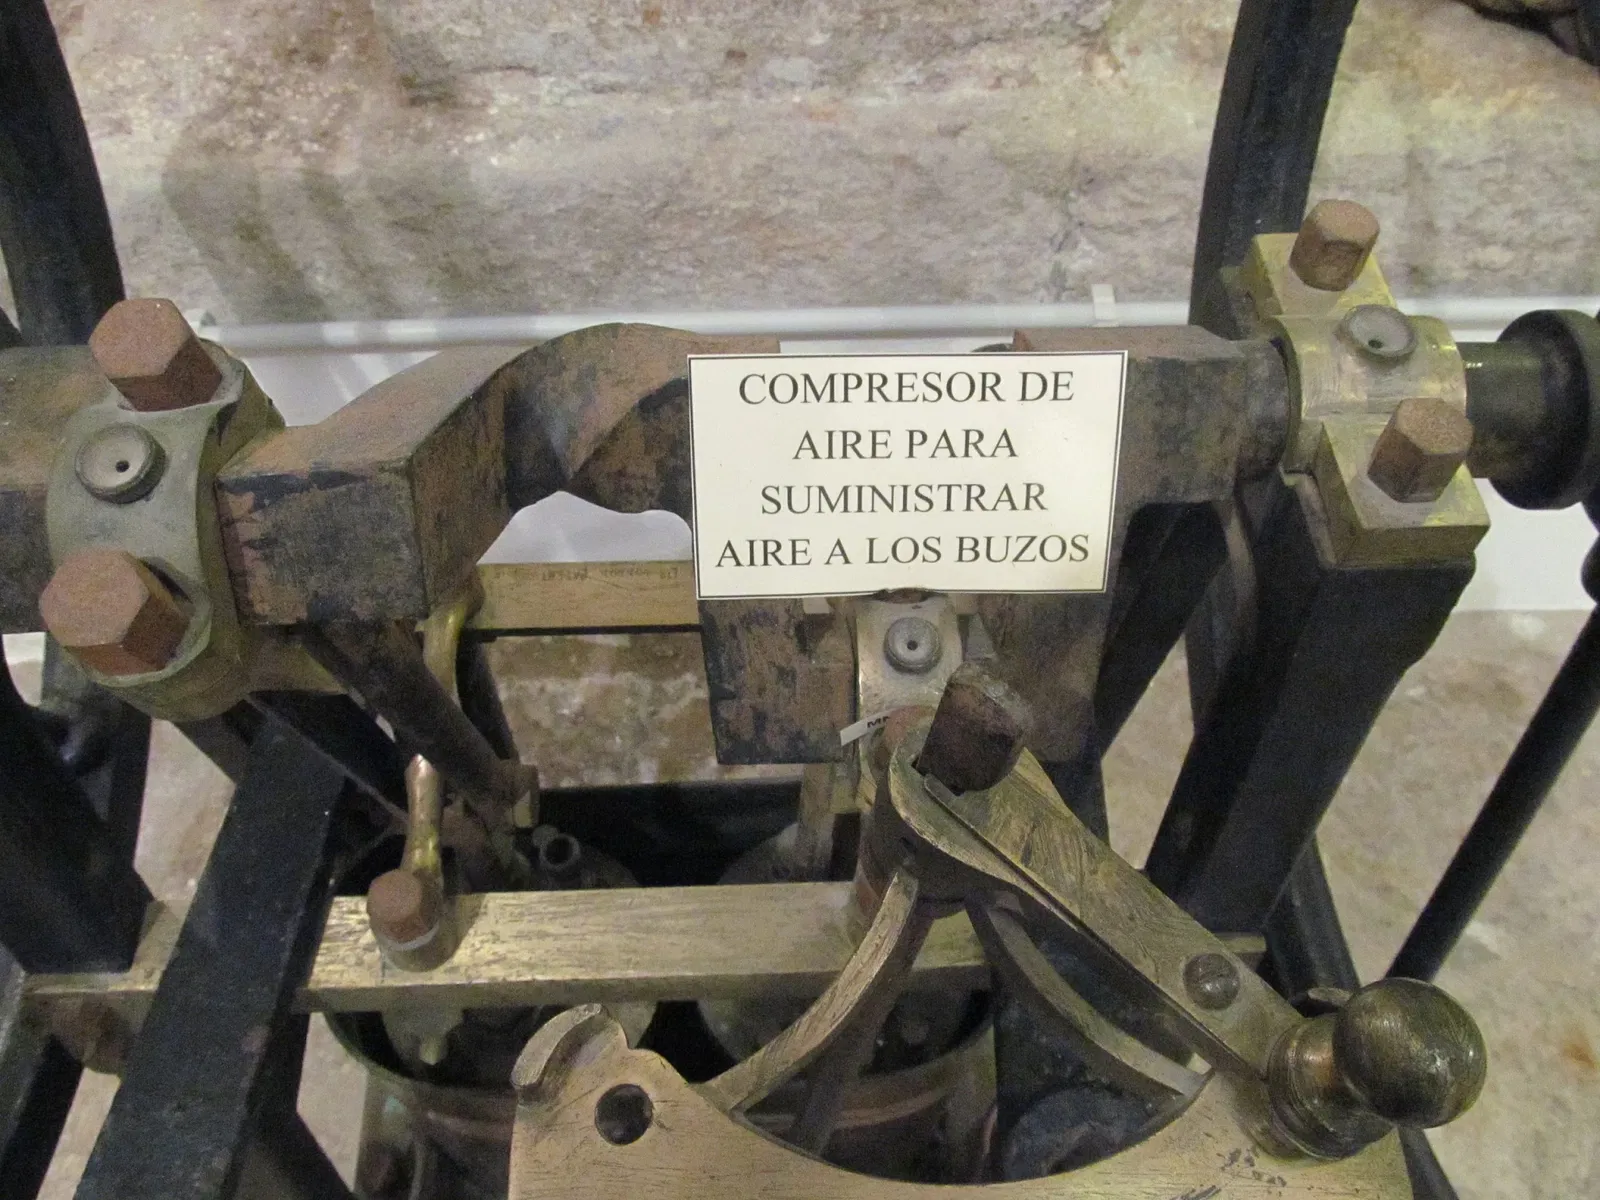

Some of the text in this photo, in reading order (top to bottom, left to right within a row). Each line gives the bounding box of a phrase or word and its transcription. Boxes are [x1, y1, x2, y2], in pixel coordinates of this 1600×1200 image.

[740, 371, 1074, 405] COMPRESOR DE
[793, 428, 1018, 460] AIRE PARA
[761, 483, 1047, 514] SUMINISTRAR
[716, 534, 1090, 568] AIRE A LOS BUZOS
